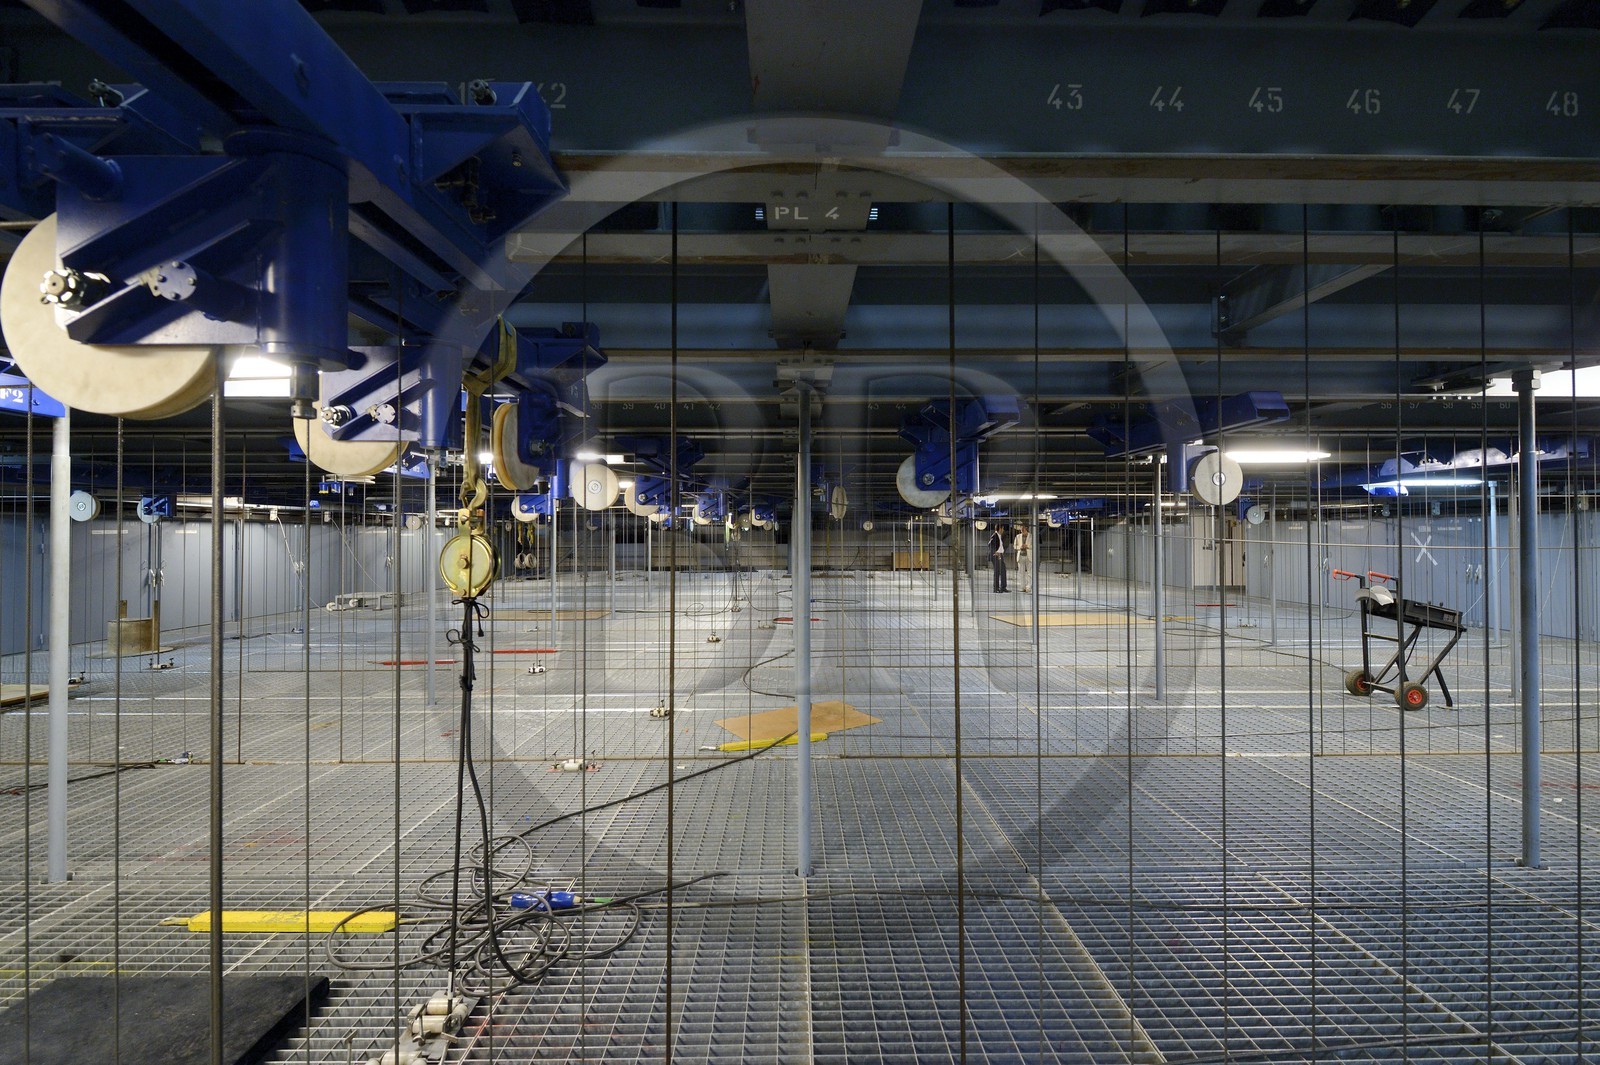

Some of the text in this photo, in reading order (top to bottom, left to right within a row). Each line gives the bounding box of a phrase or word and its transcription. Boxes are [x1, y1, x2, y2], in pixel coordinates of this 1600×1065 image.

[1047, 84, 1083, 110] 43
[1149, 86, 1185, 112] 44
[1247, 87, 1283, 113] 45
[1346, 89, 1381, 115] 46
[1447, 89, 1480, 114] 47
[1545, 91, 1579, 117] 48
[774, 206, 840, 220] PL 4
